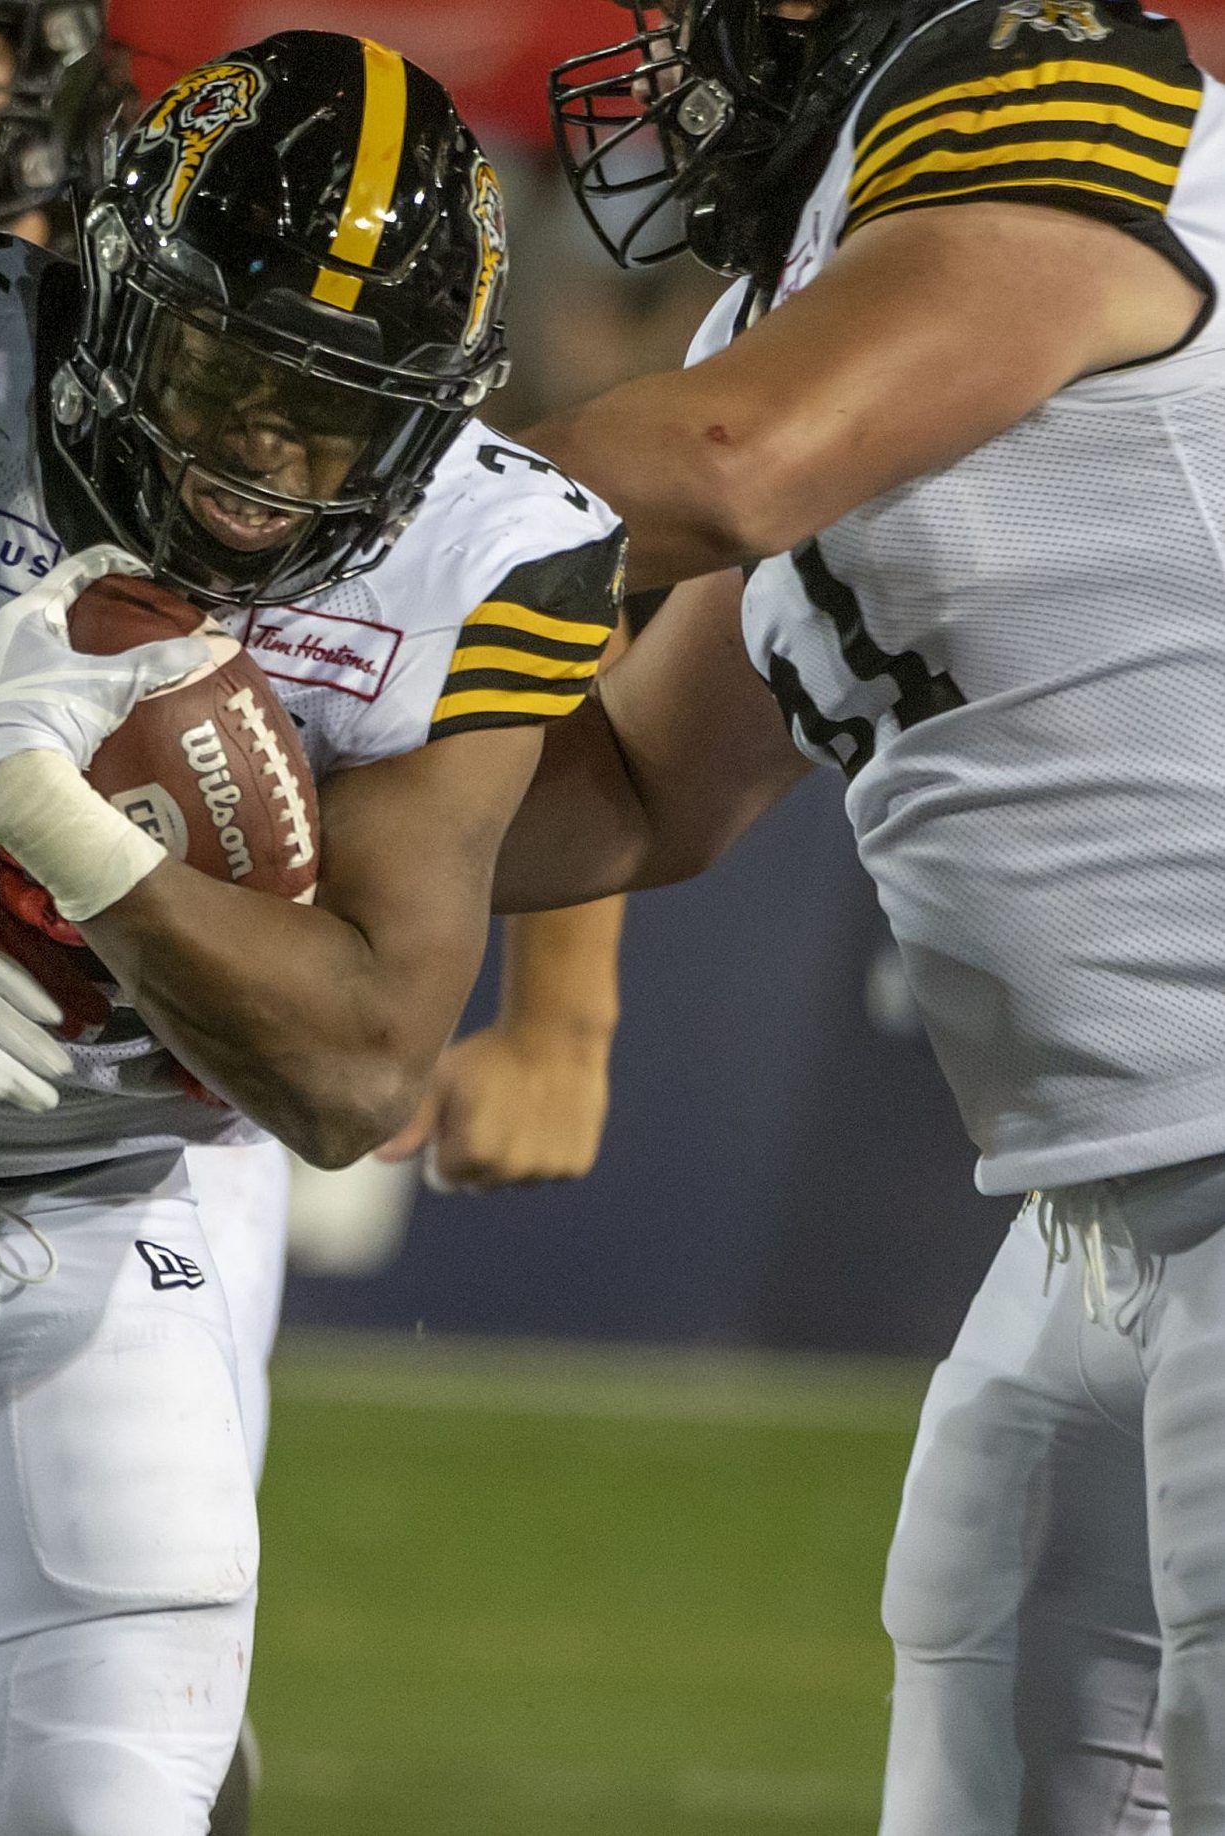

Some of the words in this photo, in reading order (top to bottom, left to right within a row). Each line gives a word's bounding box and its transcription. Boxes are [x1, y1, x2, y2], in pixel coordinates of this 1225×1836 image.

[253, 623, 294, 656] Tim
[292, 633, 376, 674] Hortons
[124, 798, 168, 849] CF
[180, 718, 254, 881] Wilson
